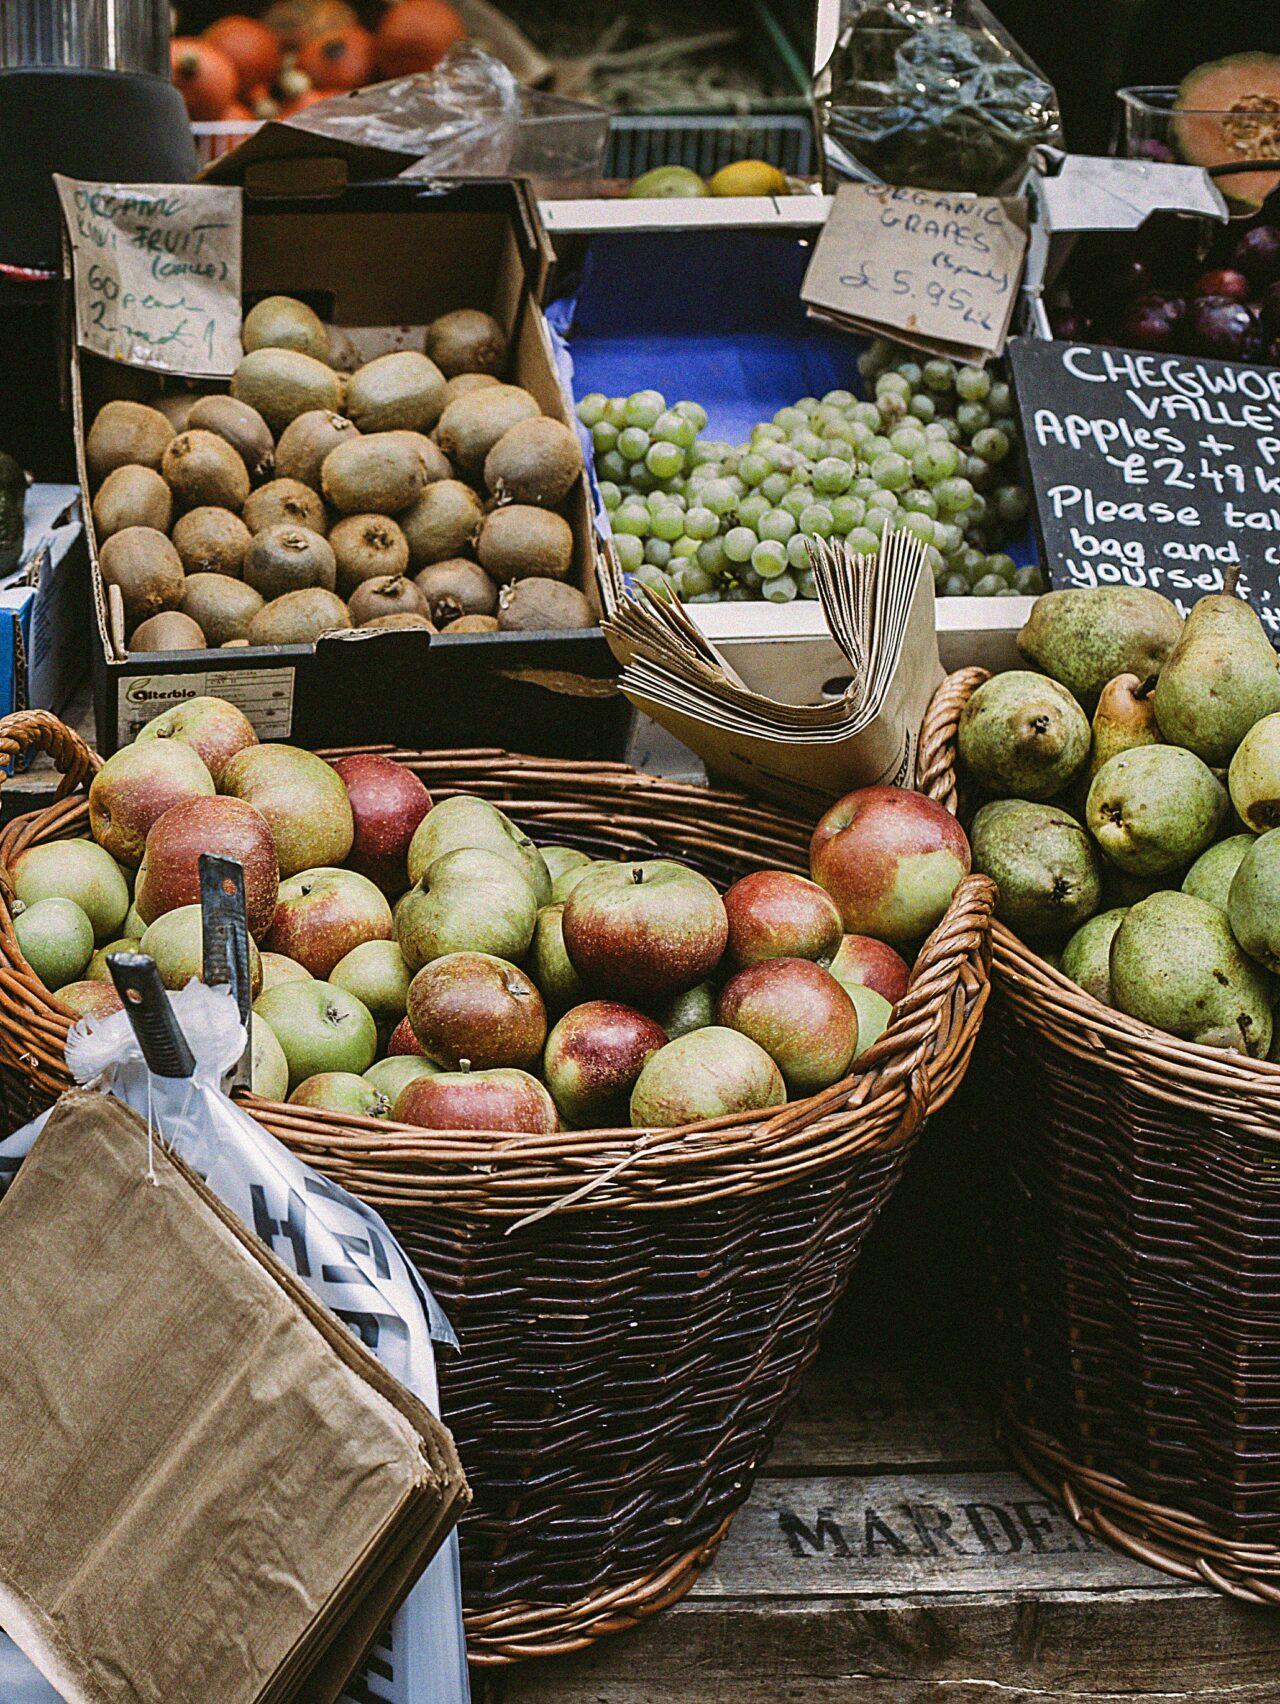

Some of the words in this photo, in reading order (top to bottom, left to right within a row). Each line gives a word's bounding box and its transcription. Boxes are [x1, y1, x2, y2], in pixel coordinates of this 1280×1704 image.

[865, 182, 1002, 226] ORGANIC
[131, 223, 231, 255] FRUIT
[880, 207, 990, 253] GRAPES
[1034, 409, 1186, 454] Apples
[1198, 434, 1235, 456] +
[1105, 453, 1246, 494] £2.49
[1047, 485, 1201, 526] Please
[1069, 527, 1146, 567] bag
[1162, 540, 1241, 562] and
